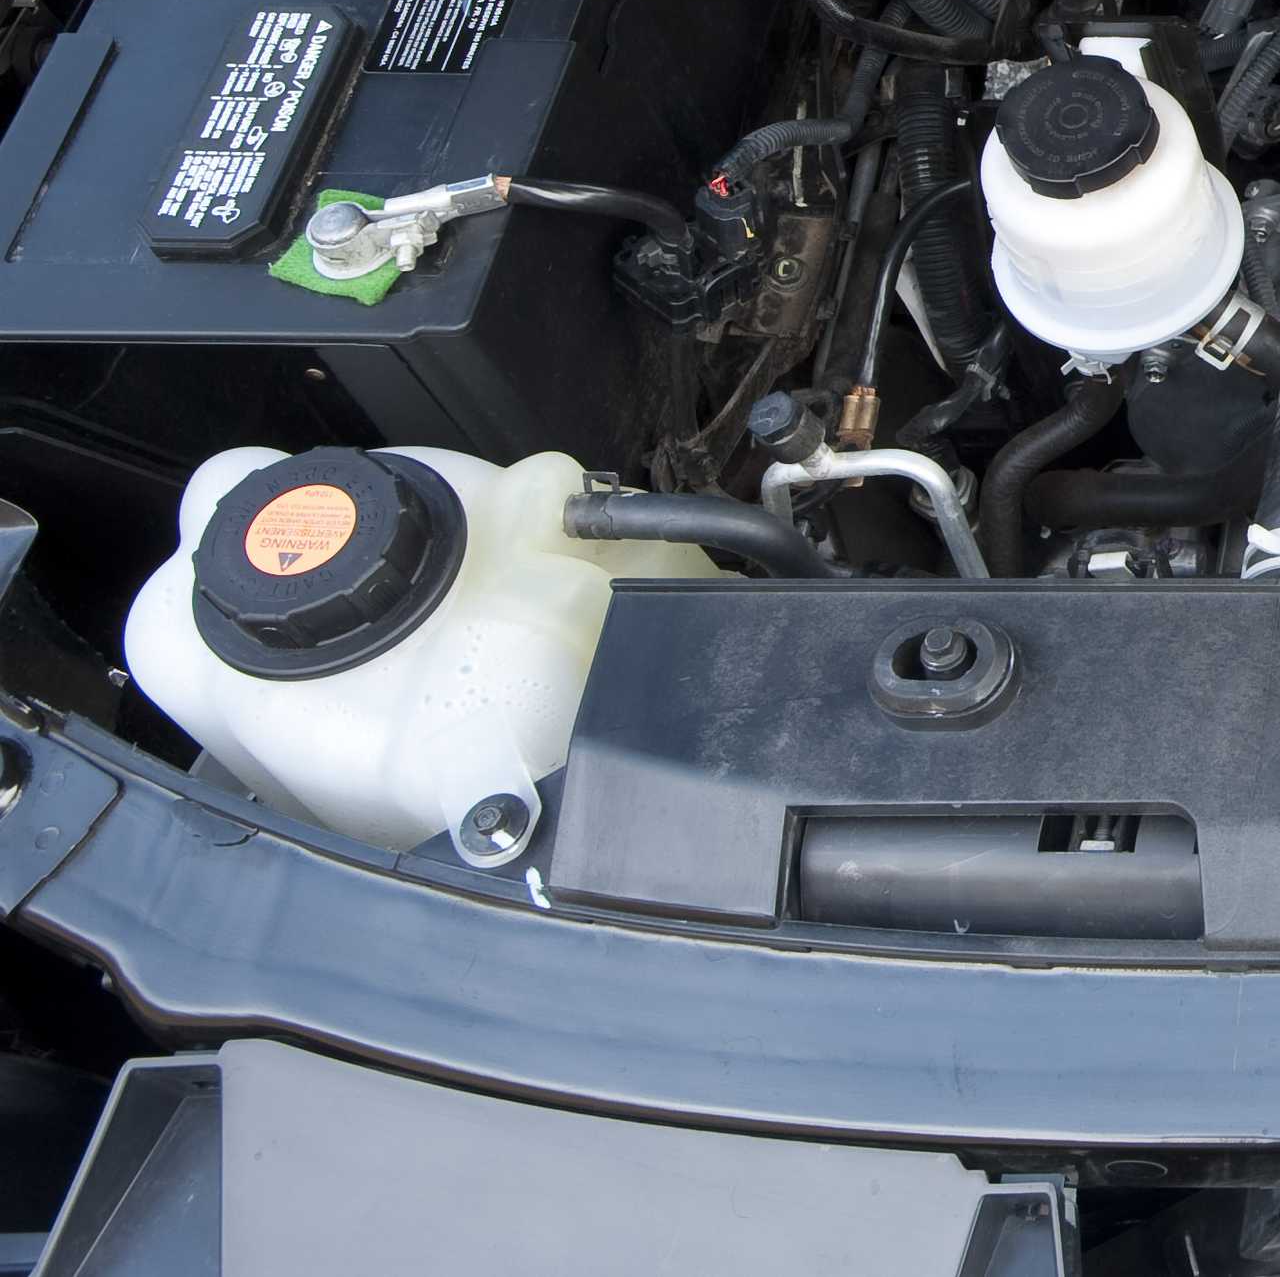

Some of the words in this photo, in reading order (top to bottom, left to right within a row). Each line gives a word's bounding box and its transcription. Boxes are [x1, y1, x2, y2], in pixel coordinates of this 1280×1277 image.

[295, 35, 327, 79] DANGER
[270, 90, 304, 132] POISON
[254, 528, 347, 538] AVERTISSEMENT
[260, 538, 330, 550] WARNING
